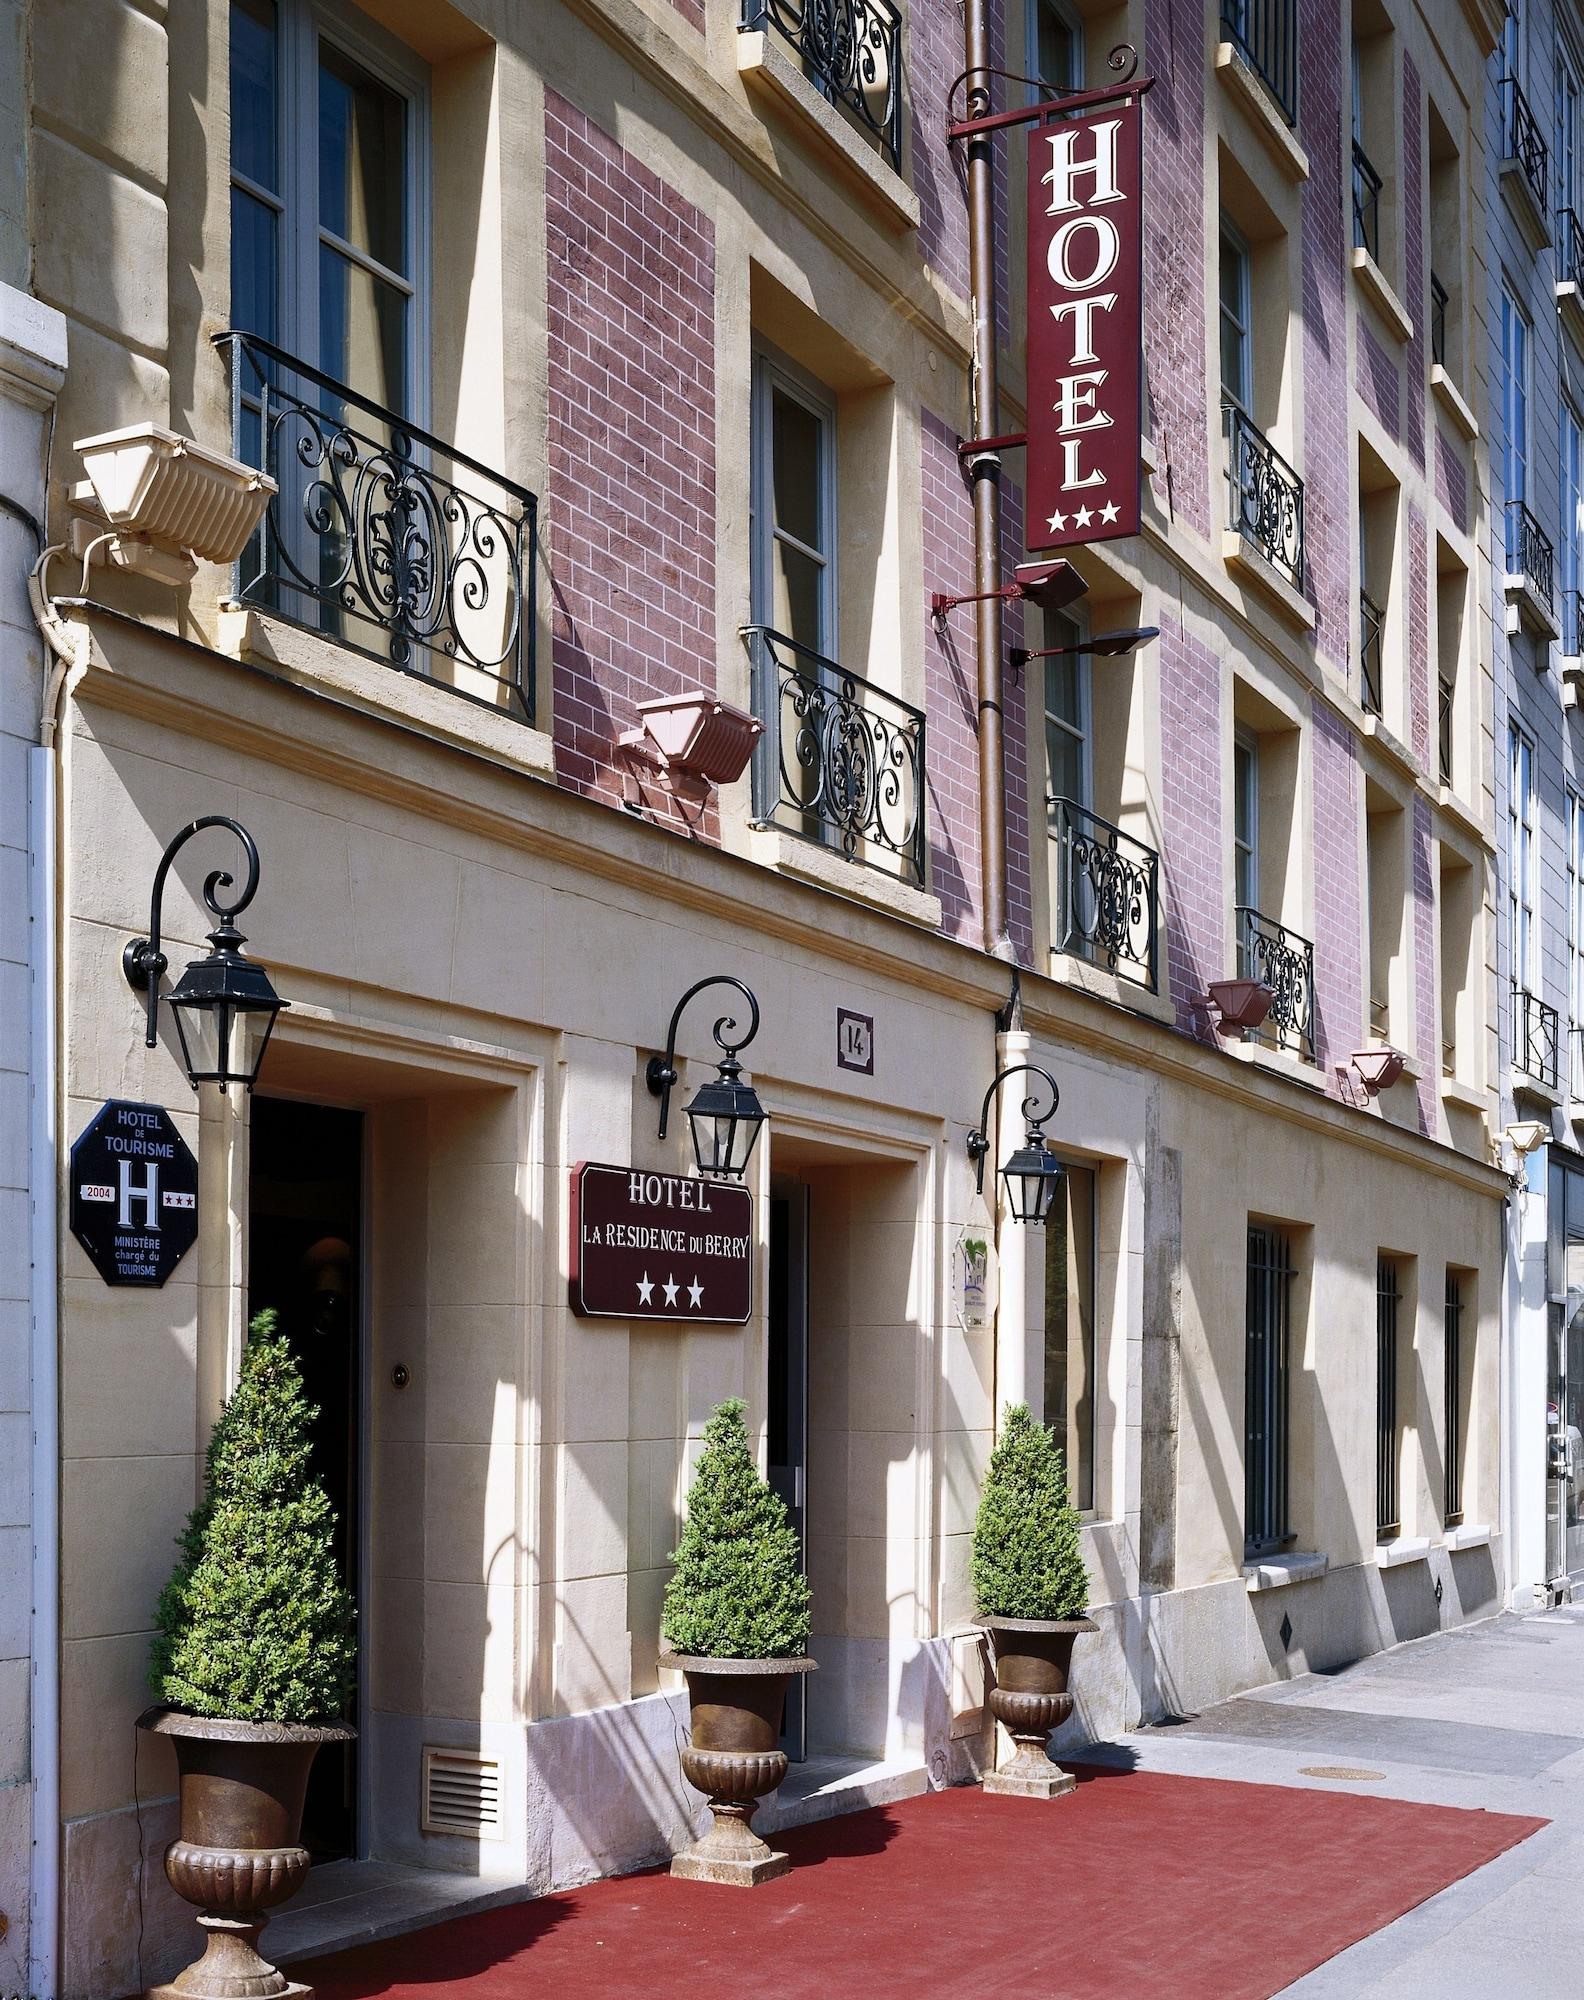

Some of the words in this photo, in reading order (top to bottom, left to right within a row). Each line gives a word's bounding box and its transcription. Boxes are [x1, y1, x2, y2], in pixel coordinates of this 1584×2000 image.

[1041, 119, 1128, 491] HOTEL
[848, 1025, 864, 1055] 14
[117, 1110, 162, 1129] HOTEL
[135, 1129, 144, 1138] DE
[105, 1136, 174, 1158] TOURISME
[87, 1186, 110, 1198] 2004
[117, 1159, 161, 1232] H
[628, 1172, 712, 1213] HOTEL
[114, 1236, 160, 1249] MINISTÈRE
[583, 1225, 601, 1244] LA
[605, 1223, 686, 1253] RESIDENCE
[689, 1236, 703, 1254] DU
[705, 1234, 750, 1259] BERRY
[114, 1250, 145, 1262] chargé
[149, 1252, 160, 1261] du
[117, 1263, 157, 1276] TOURISME
